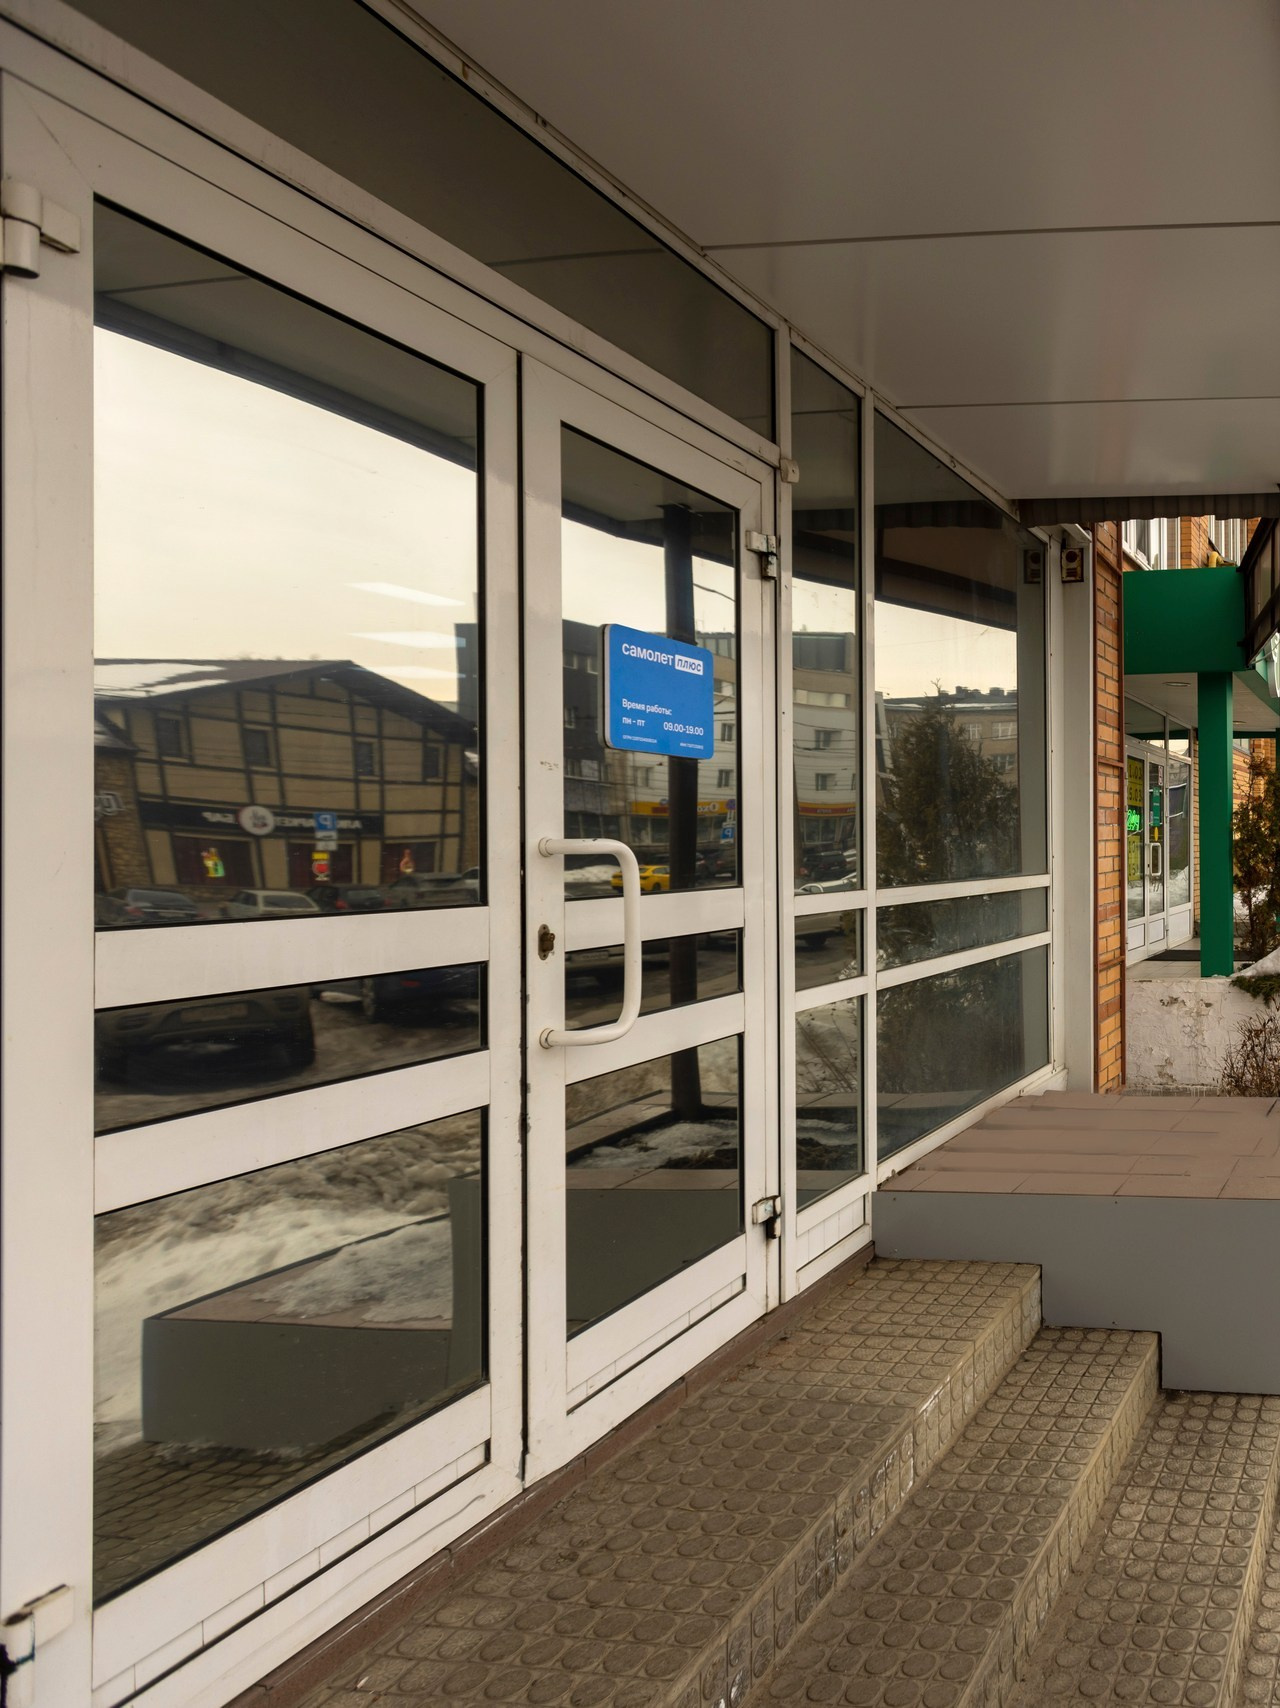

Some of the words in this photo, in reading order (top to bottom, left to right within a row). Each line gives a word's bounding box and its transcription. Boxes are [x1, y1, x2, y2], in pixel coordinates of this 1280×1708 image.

[621, 643, 674, 666] самолет
[676, 658, 702, 672] плюс
[622, 698, 645, 711] Время
[622, 717, 632, 725] пн
[637, 719, 645, 727] пт
[663, 721, 704, 736] 09.00-19.00
